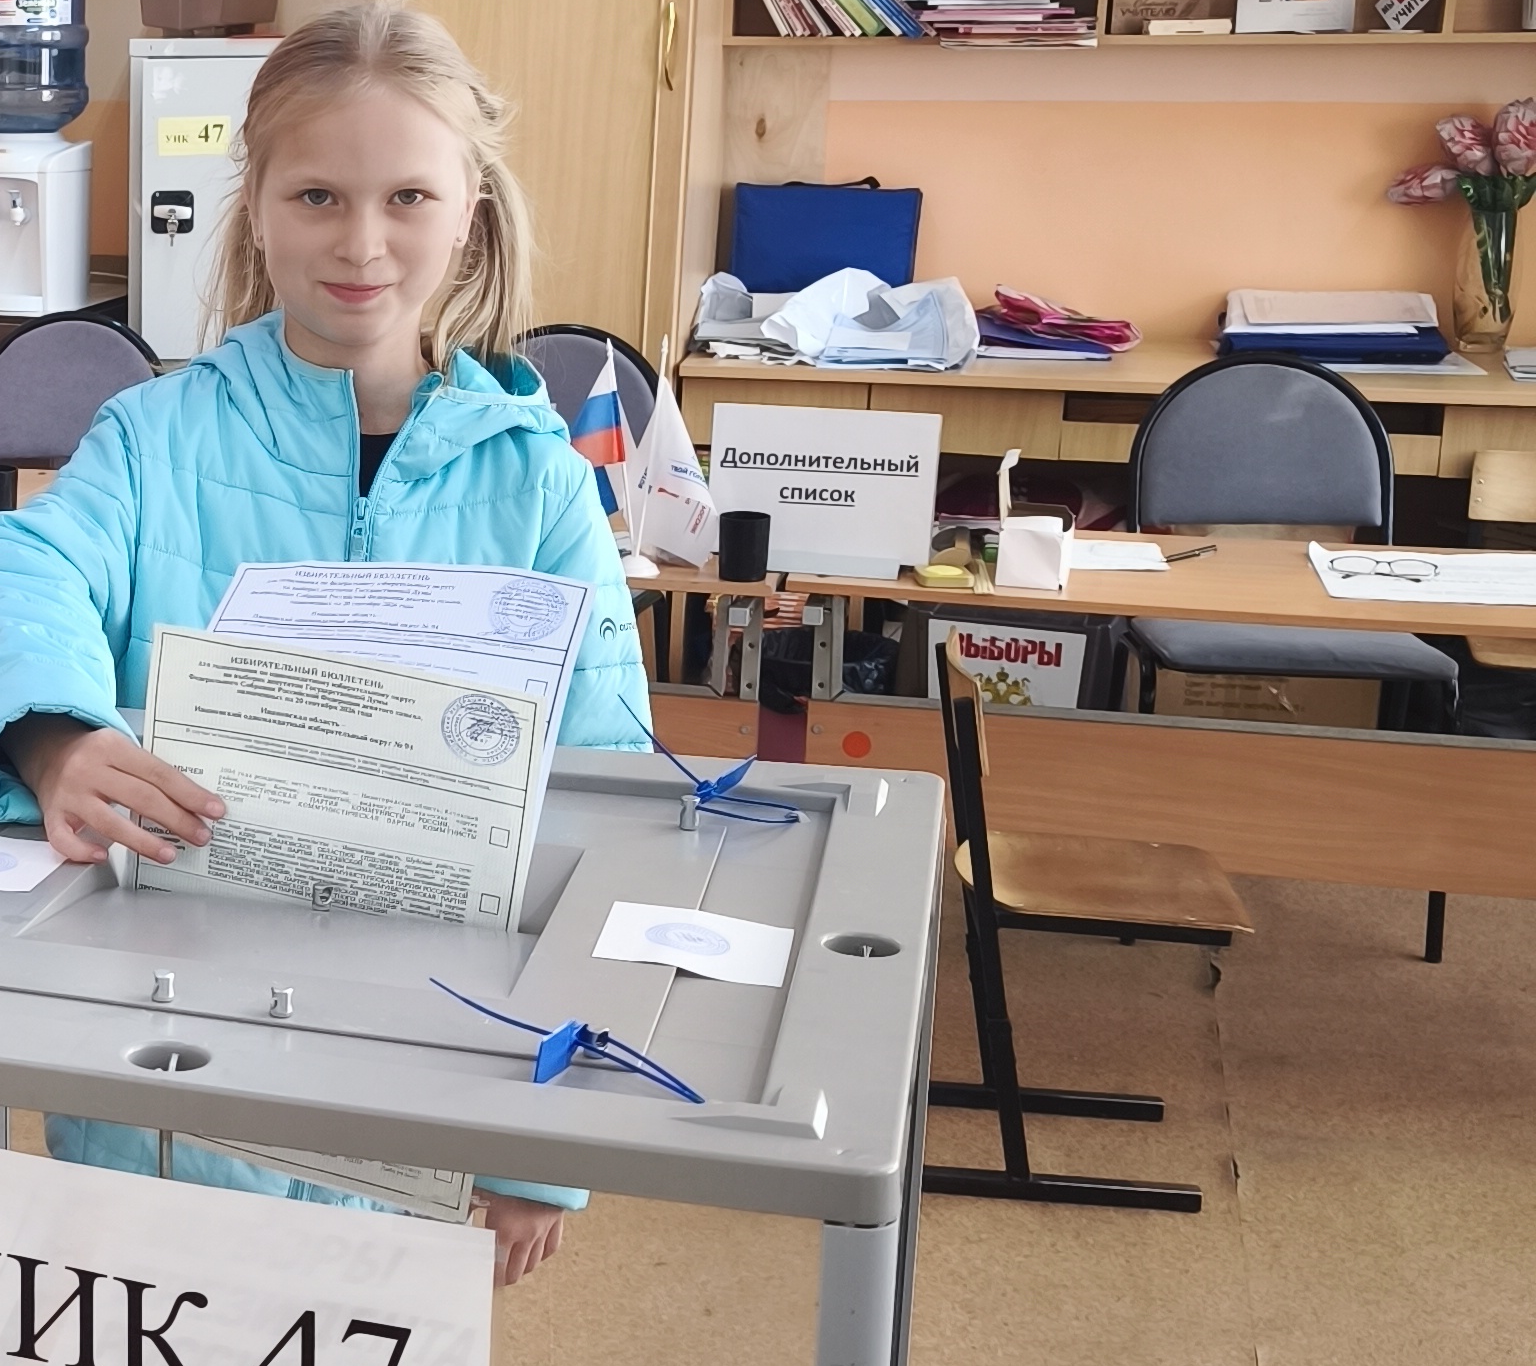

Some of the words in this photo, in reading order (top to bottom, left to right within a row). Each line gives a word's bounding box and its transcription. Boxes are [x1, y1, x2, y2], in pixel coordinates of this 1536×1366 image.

[1380, 0, 1395, 16] МЫ
[166, 135, 189, 144] УИК
[198, 123, 224, 143] 47
[720, 446, 920, 476] Дополнительный
[779, 486, 856, 505] список
[230, 656, 319, 677] ИЗБИРАТЕЛЬНЫЙ
[321, 670, 385, 690] БЮЛЛЕТЕНЬ
